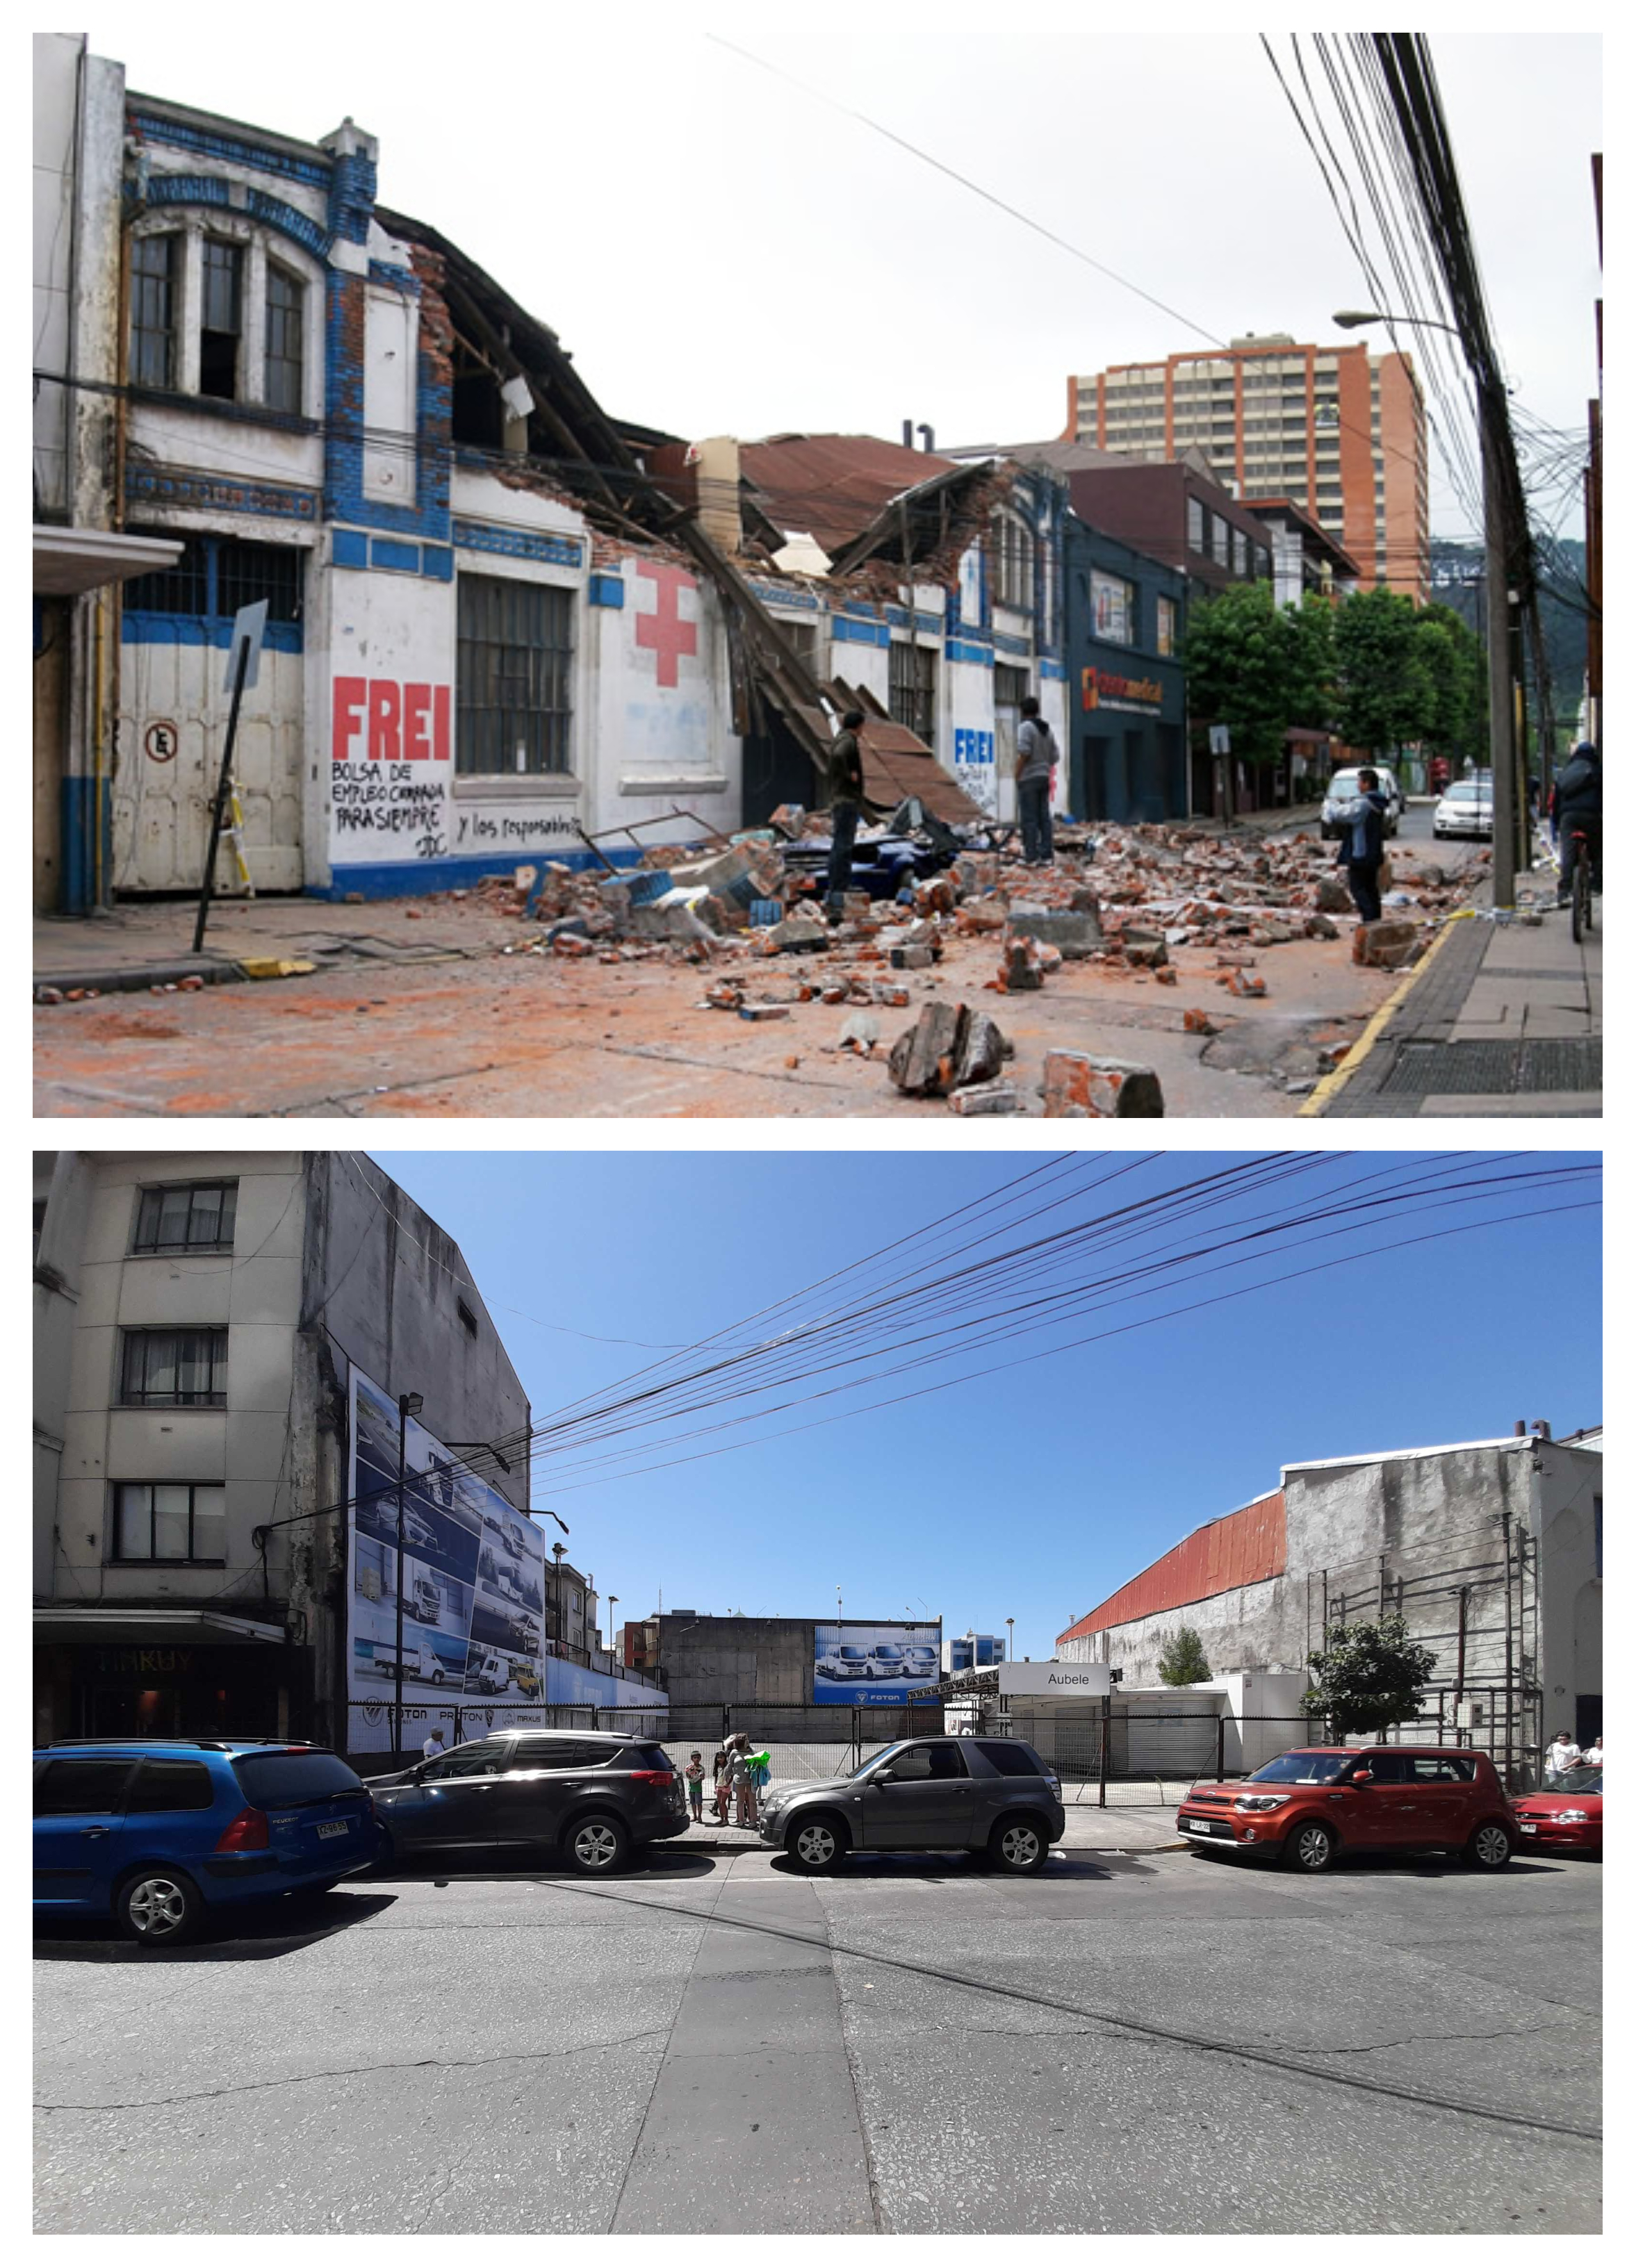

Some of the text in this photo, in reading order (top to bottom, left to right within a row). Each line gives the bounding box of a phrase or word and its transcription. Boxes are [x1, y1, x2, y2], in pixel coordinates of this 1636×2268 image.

[333, 677, 450, 761] FREI
[955, 728, 995, 764] FREI
[333, 763, 411, 783] BOLSA DE
[332, 783, 387, 804] EMPLEO
[473, 812, 497, 839] los
[1048, 1673, 1089, 1685] Aubele
